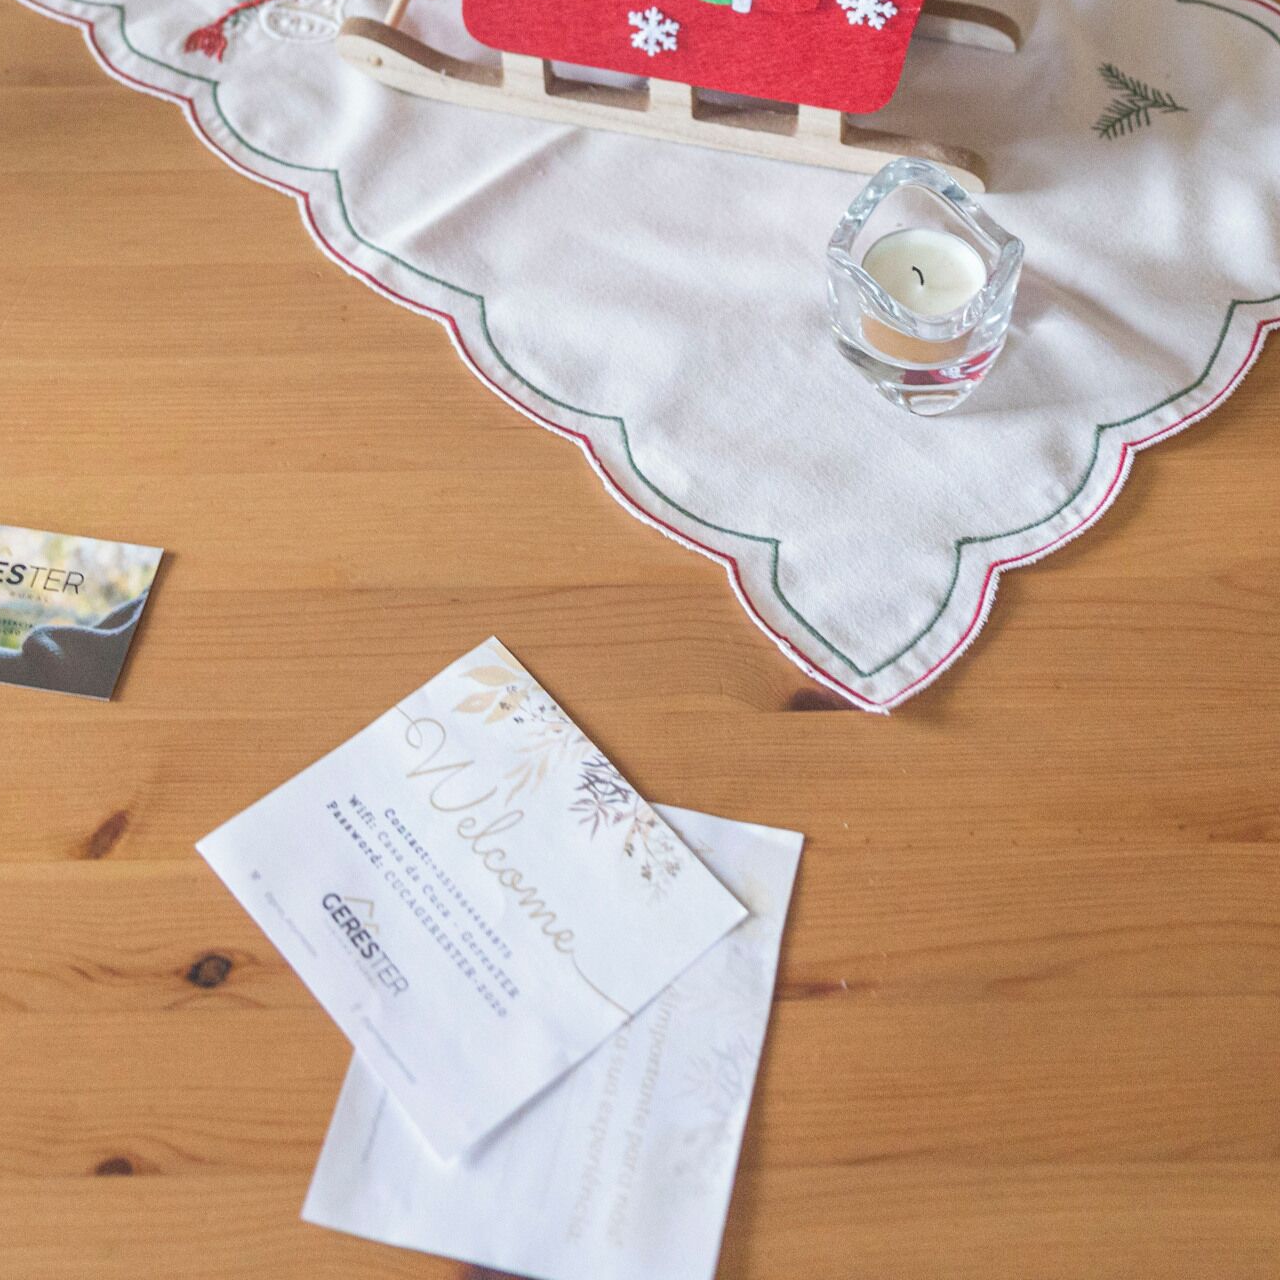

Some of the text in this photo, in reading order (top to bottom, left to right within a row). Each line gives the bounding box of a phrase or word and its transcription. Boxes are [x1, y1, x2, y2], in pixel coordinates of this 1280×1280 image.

[325, 799, 383, 869] Password:
[347, 793, 376, 829] Wifi:
[376, 830, 403, 863] Casa
[404, 865, 420, 882] da
[421, 883, 450, 918] Cuca
[460, 931, 519, 999] GeresTER
[400, 712, 578, 958] Welcome
[321, 892, 408, 996] GERESTER
